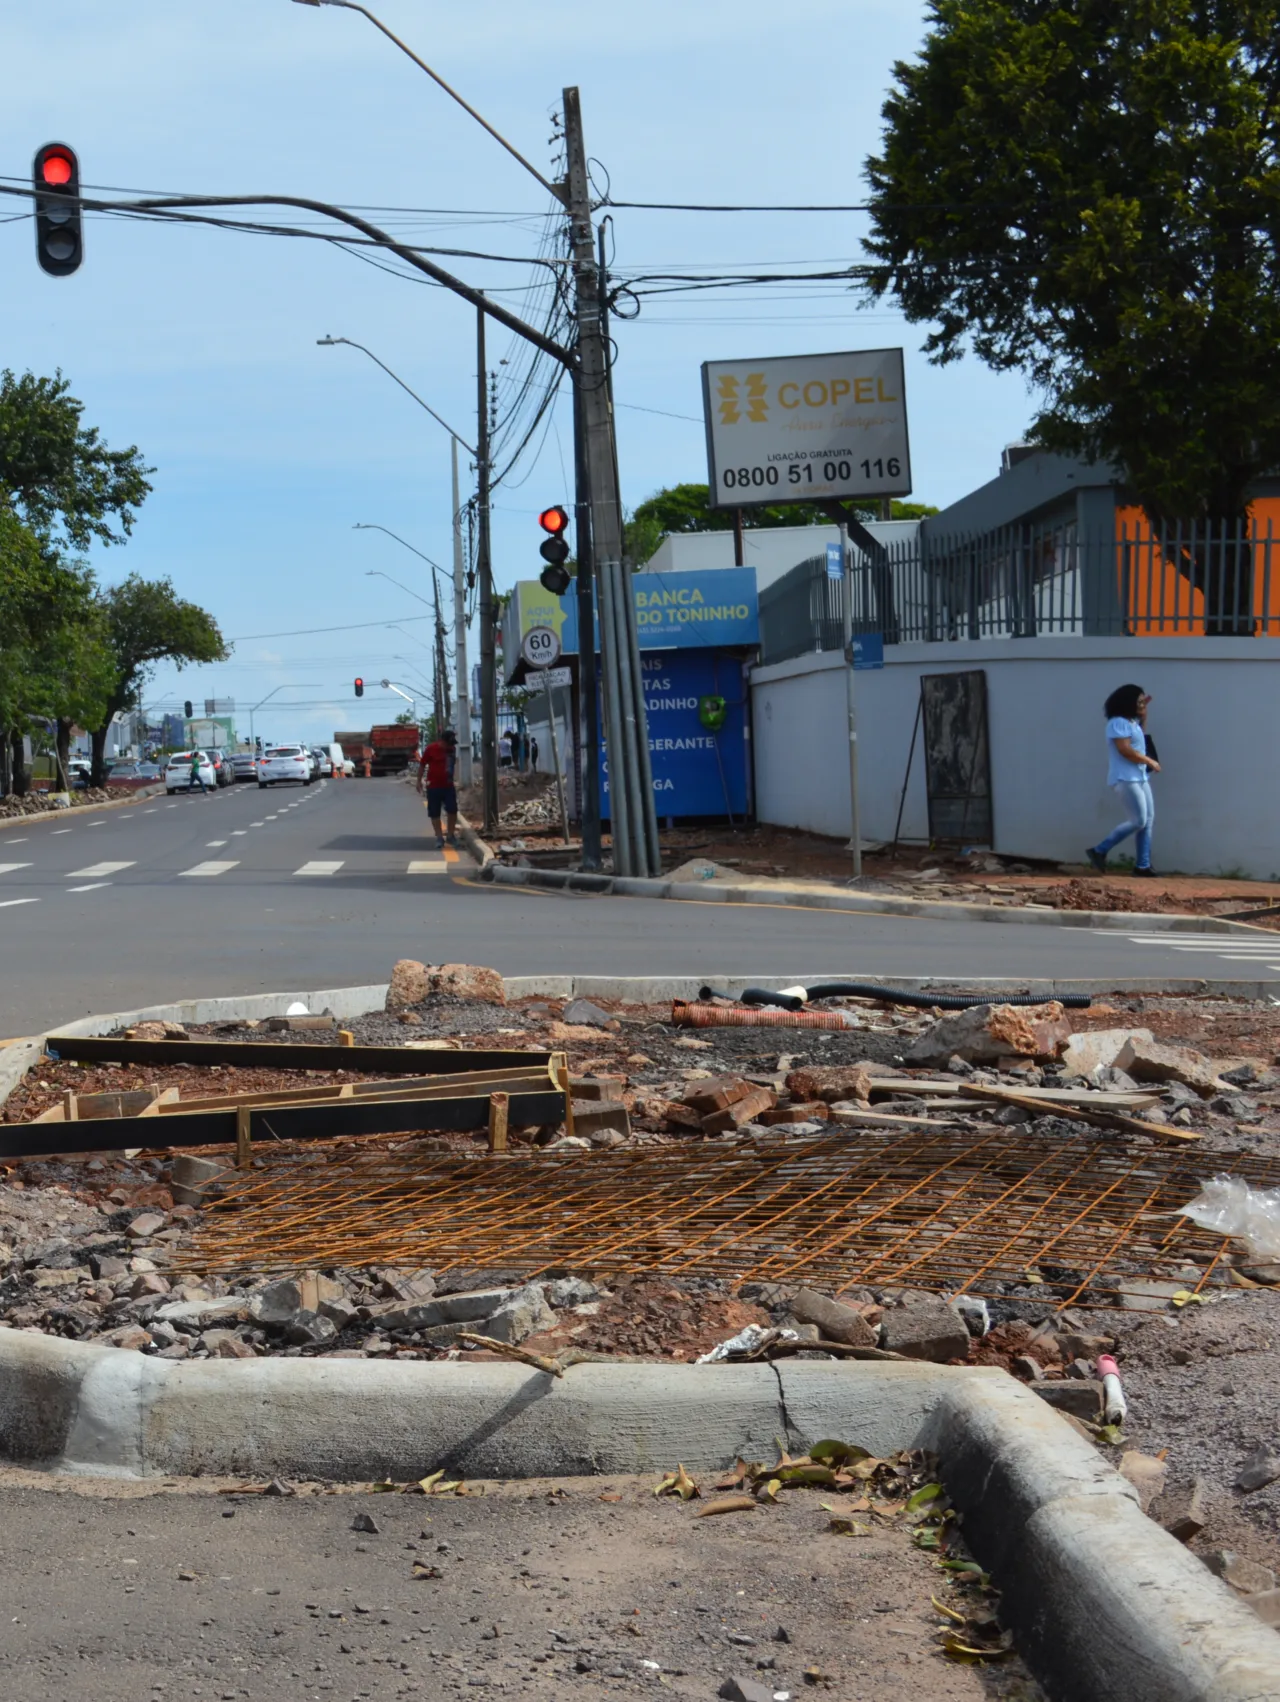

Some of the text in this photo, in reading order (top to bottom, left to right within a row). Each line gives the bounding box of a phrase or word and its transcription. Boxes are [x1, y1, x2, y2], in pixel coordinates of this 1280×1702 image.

[777, 377, 897, 409] COPEL
[767, 448, 853, 462] LIGAÇÃO GRATUITA
[723, 457, 901, 488] 0800 51 00 116
[636, 588, 705, 607] BANCA
[527, 606, 555, 617] AQUI
[637, 604, 749, 625] DO TONINHO
[529, 618, 553, 627] TEM
[529, 633, 551, 650] 60
[531, 650, 552, 660] Km/h
